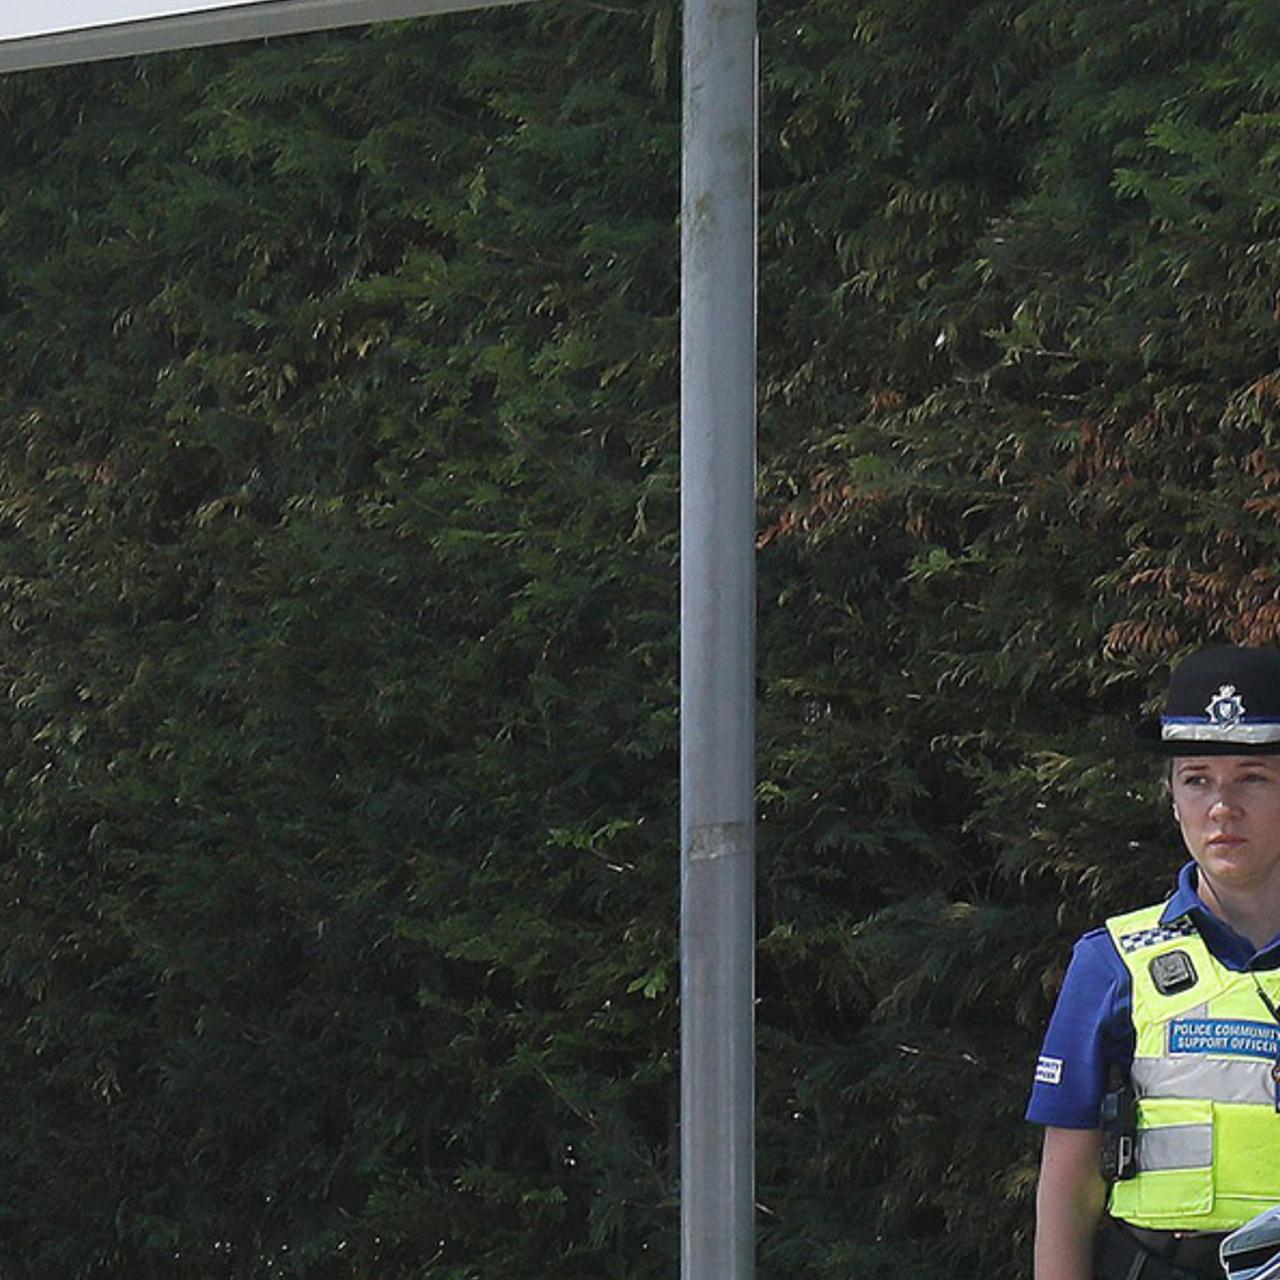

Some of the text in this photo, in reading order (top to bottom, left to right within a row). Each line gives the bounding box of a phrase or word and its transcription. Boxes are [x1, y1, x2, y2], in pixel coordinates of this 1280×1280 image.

[1174, 1024, 1213, 1036] POLICE
[1178, 1037, 1277, 1052] SUPPORT OFFICER
